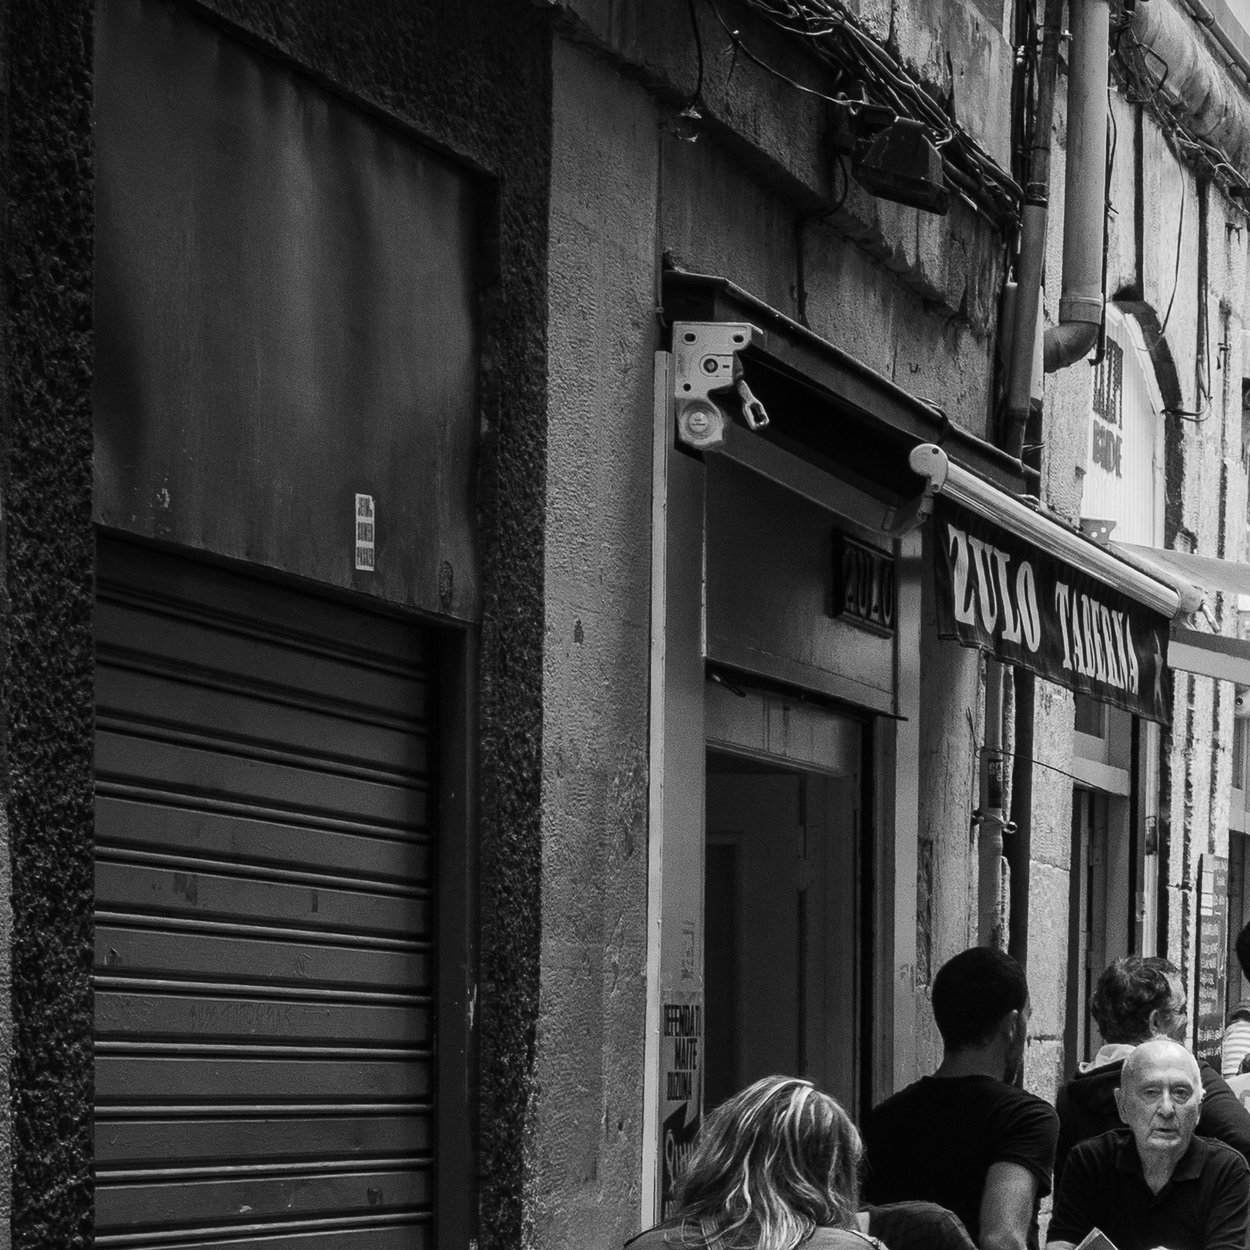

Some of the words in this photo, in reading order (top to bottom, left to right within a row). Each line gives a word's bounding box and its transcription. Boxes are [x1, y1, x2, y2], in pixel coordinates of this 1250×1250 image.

[948, 523, 1041, 653] ZULO
[1055, 580, 1139, 695] TABERNA
[675, 1038, 698, 1070] MAITE
